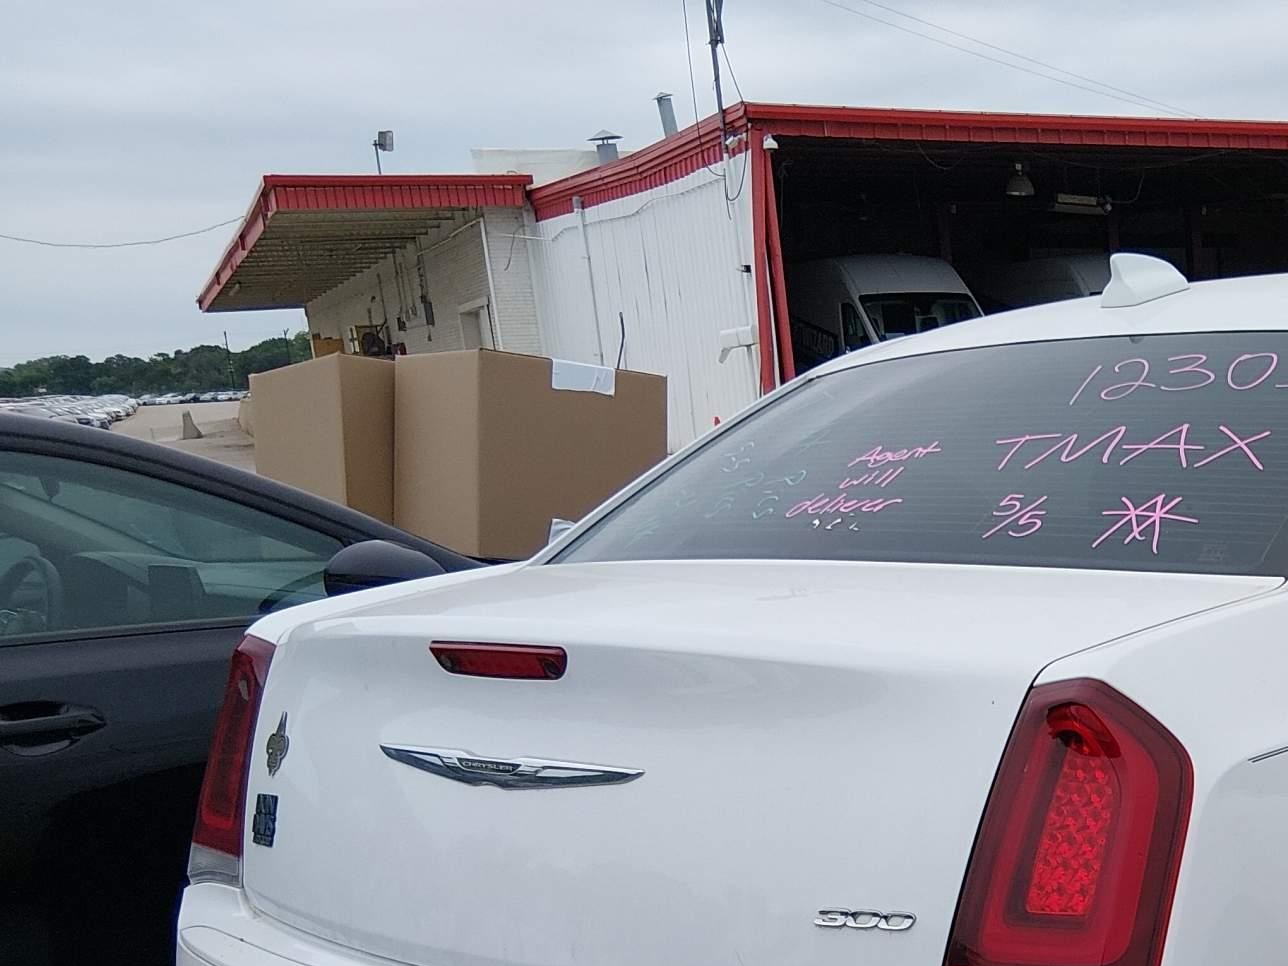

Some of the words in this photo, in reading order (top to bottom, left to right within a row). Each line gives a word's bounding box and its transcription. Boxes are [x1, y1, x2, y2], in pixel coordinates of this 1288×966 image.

[848, 441, 942, 468] Agent
[996, 423, 1271, 471] TMAX
[838, 466, 904, 489] will
[982, 493, 1048, 539] 5/5
[462, 760, 513, 771] CHRYSLER
[814, 907, 917, 932] 300
